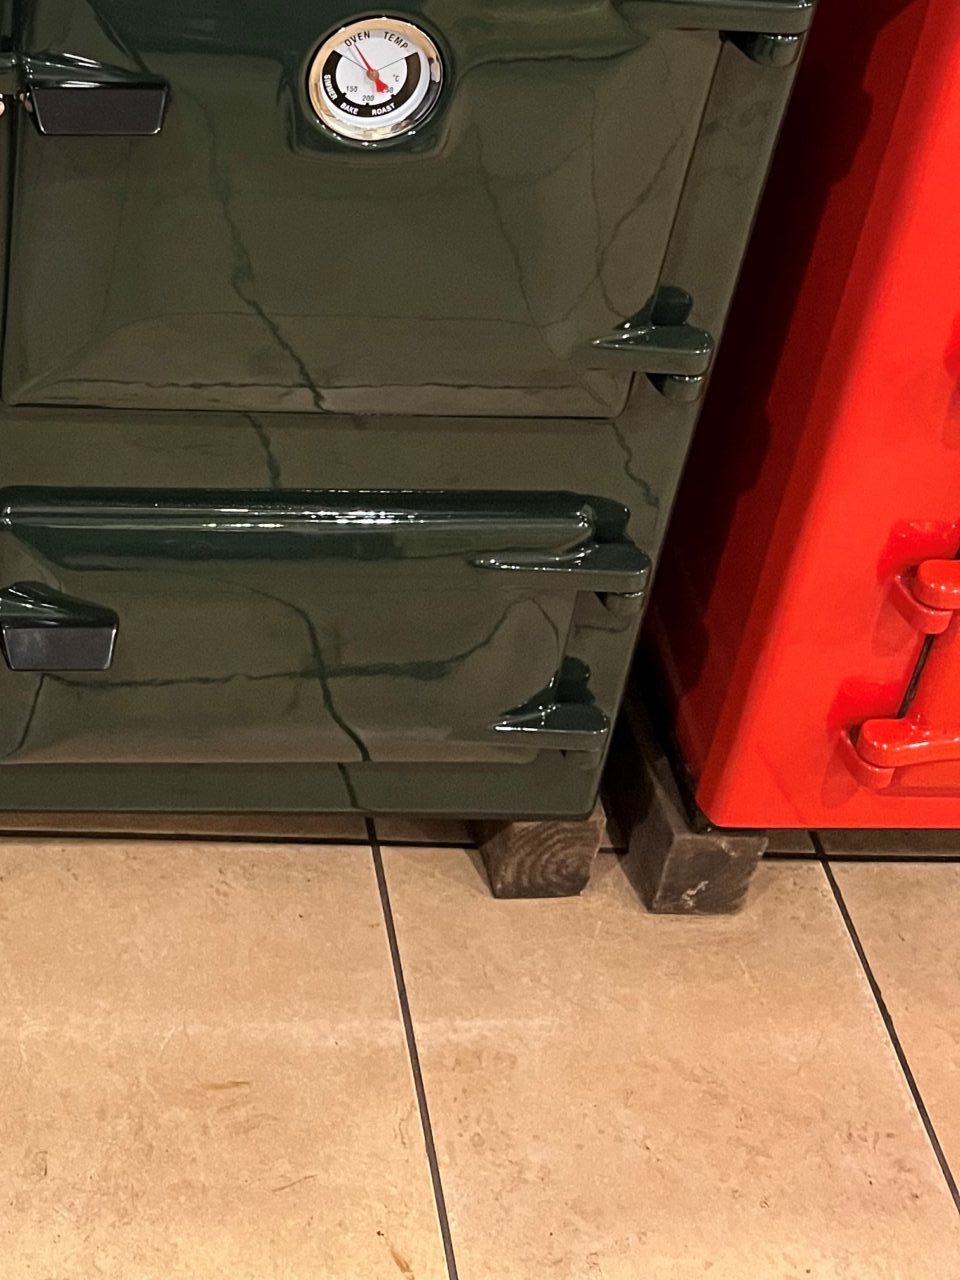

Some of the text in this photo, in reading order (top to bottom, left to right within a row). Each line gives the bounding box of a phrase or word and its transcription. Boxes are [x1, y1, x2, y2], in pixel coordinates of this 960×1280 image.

[344, 30, 409, 50] OVEN TEMP
[324, 74, 338, 100] SIMMER
[340, 102, 359, 115] BAKE
[372, 102, 396, 116] ROAST
